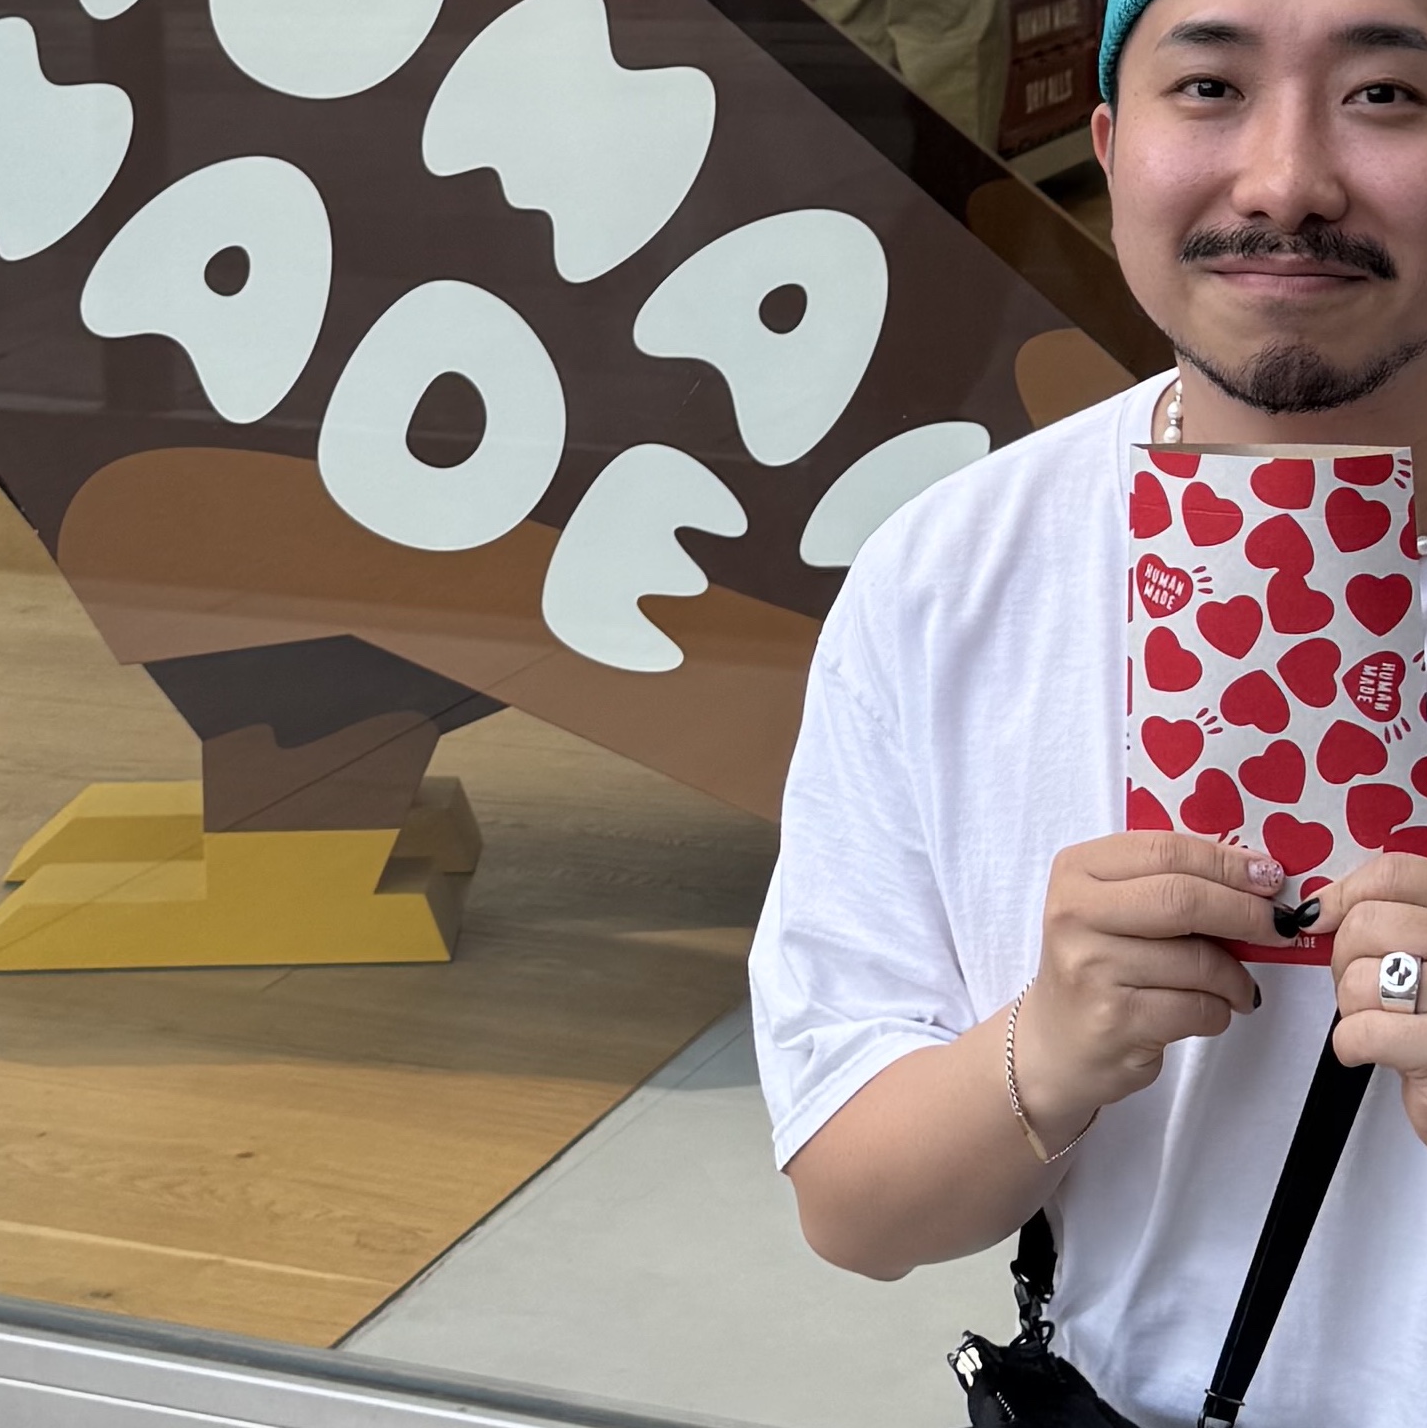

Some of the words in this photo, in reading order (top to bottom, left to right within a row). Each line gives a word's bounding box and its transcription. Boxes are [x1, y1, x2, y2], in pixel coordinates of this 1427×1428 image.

[1143, 580, 1176, 611] MADE
[1144, 563, 1185, 597] HUMAN
[1356, 664, 1378, 703] MADE
[1374, 662, 1396, 711] HUMAN
